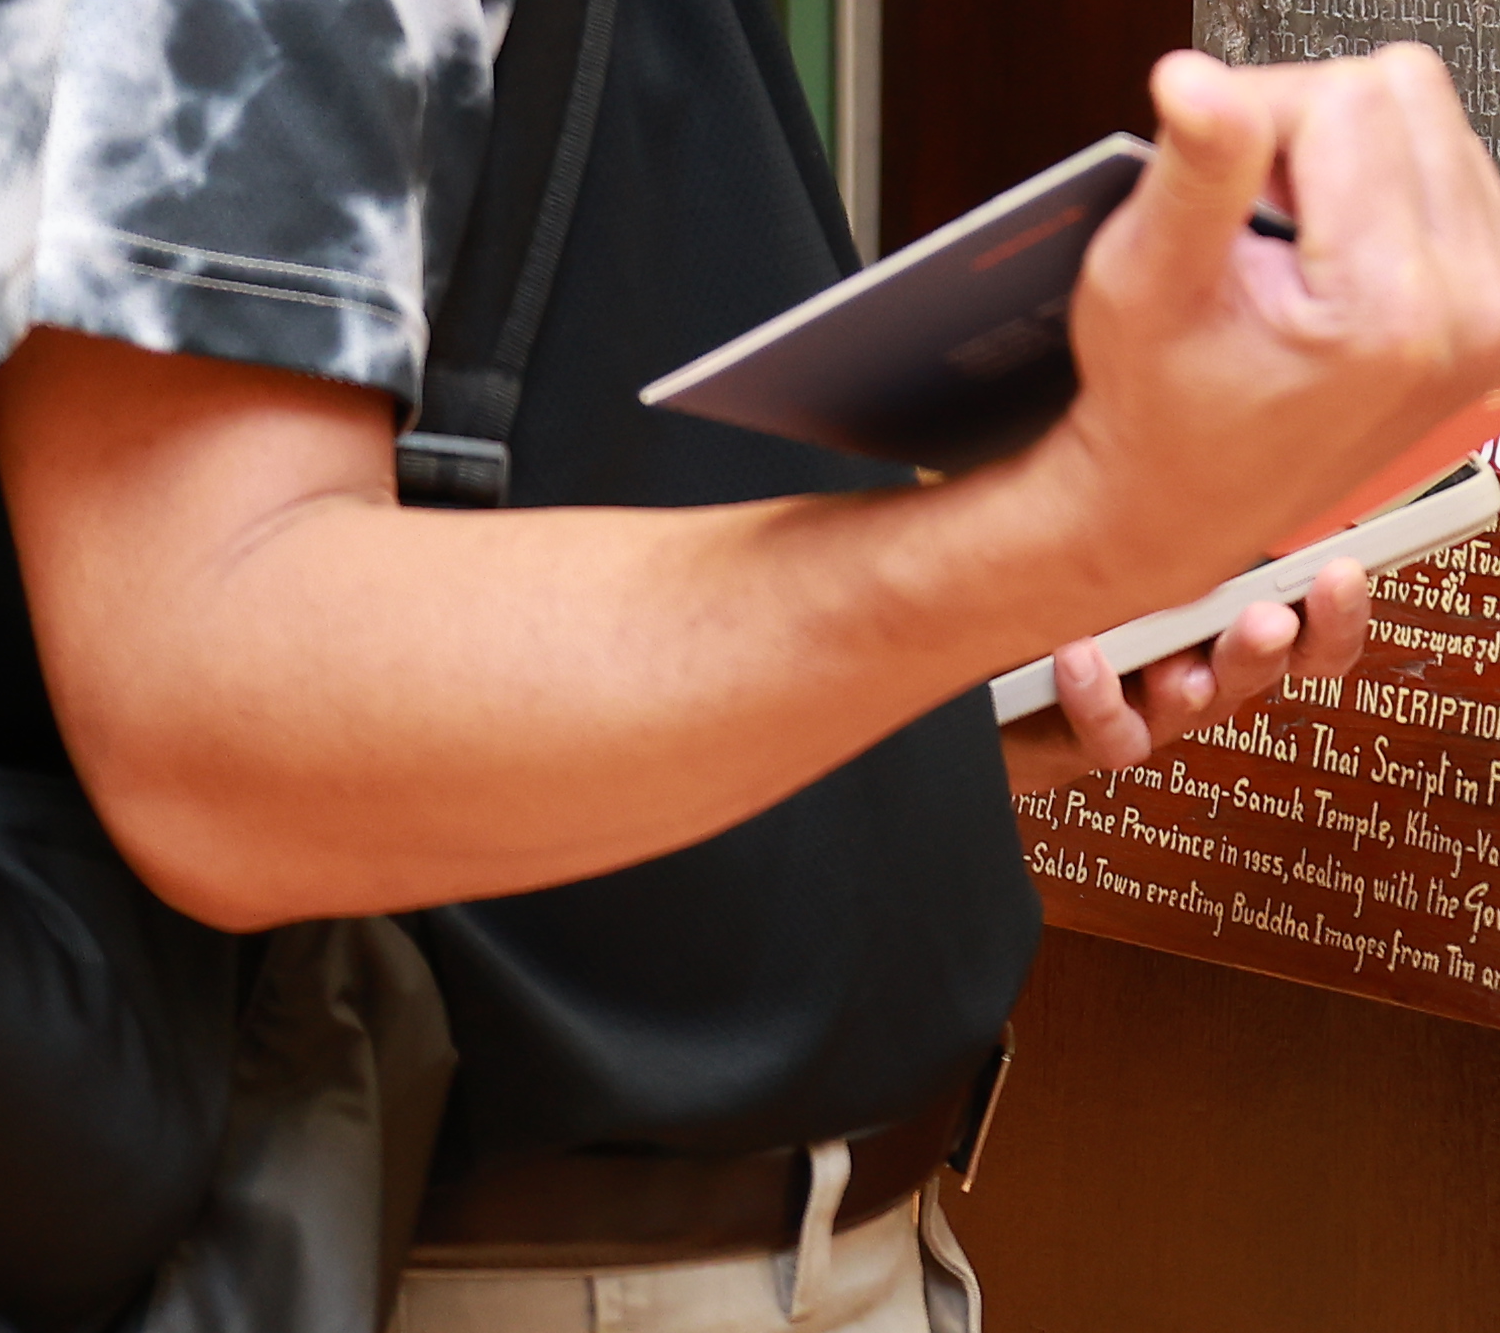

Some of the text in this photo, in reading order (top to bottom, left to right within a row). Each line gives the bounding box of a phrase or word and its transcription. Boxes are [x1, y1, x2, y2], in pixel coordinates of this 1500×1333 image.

[1169, 760, 1305, 819] Bang-Sanuk
[1314, 789, 1397, 852] Temple,
[1312, 722, 1361, 778] Thai
[1371, 735, 1452, 809] Script
[1454, 768, 1479, 806] in
[1011, 787, 1059, 831] rict,
[1064, 789, 1117, 835] Prae
[1120, 805, 1216, 862] Province
[1220, 835, 1239, 867] in
[1242, 849, 1289, 886] 1955,
[1292, 847, 1365, 918] dealing
[1373, 868, 1420, 911] with
[1426, 876, 1461, 919] the
[1096, 858, 1141, 901] Town
[1147, 880, 1225, 938] erecting
[1231, 892, 1310, 943] Buddha
[1314, 913, 1388, 974] Images
[1387, 928, 1440, 973] from
[1446, 943, 1477, 983] Tin
